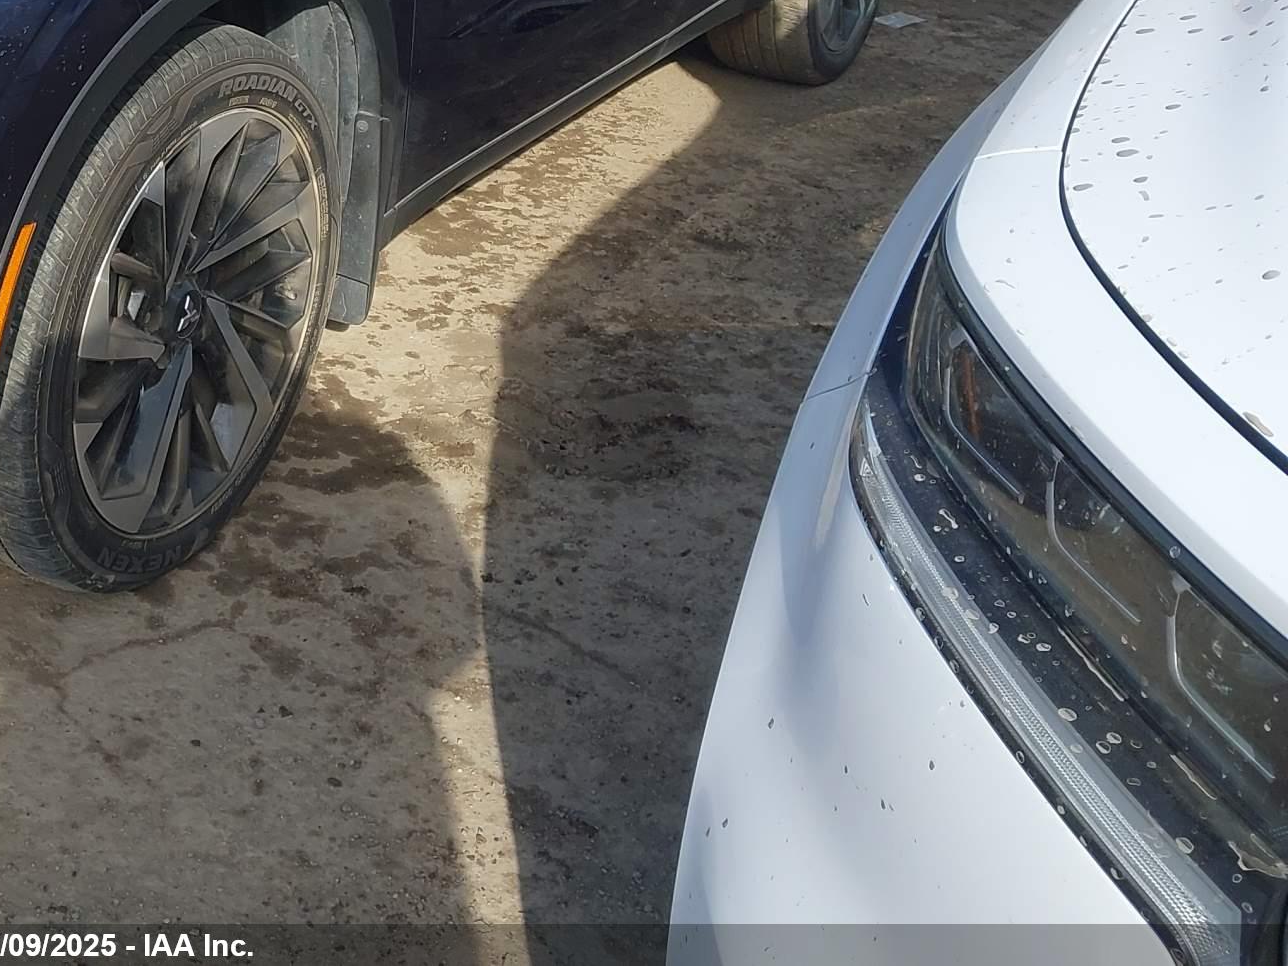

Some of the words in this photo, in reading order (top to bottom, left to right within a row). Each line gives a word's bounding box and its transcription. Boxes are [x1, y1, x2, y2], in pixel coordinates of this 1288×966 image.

[218, 74, 297, 102] ROADIAN
[294, 98, 318, 130] GTX
[97, 545, 182, 573] NEXEN
